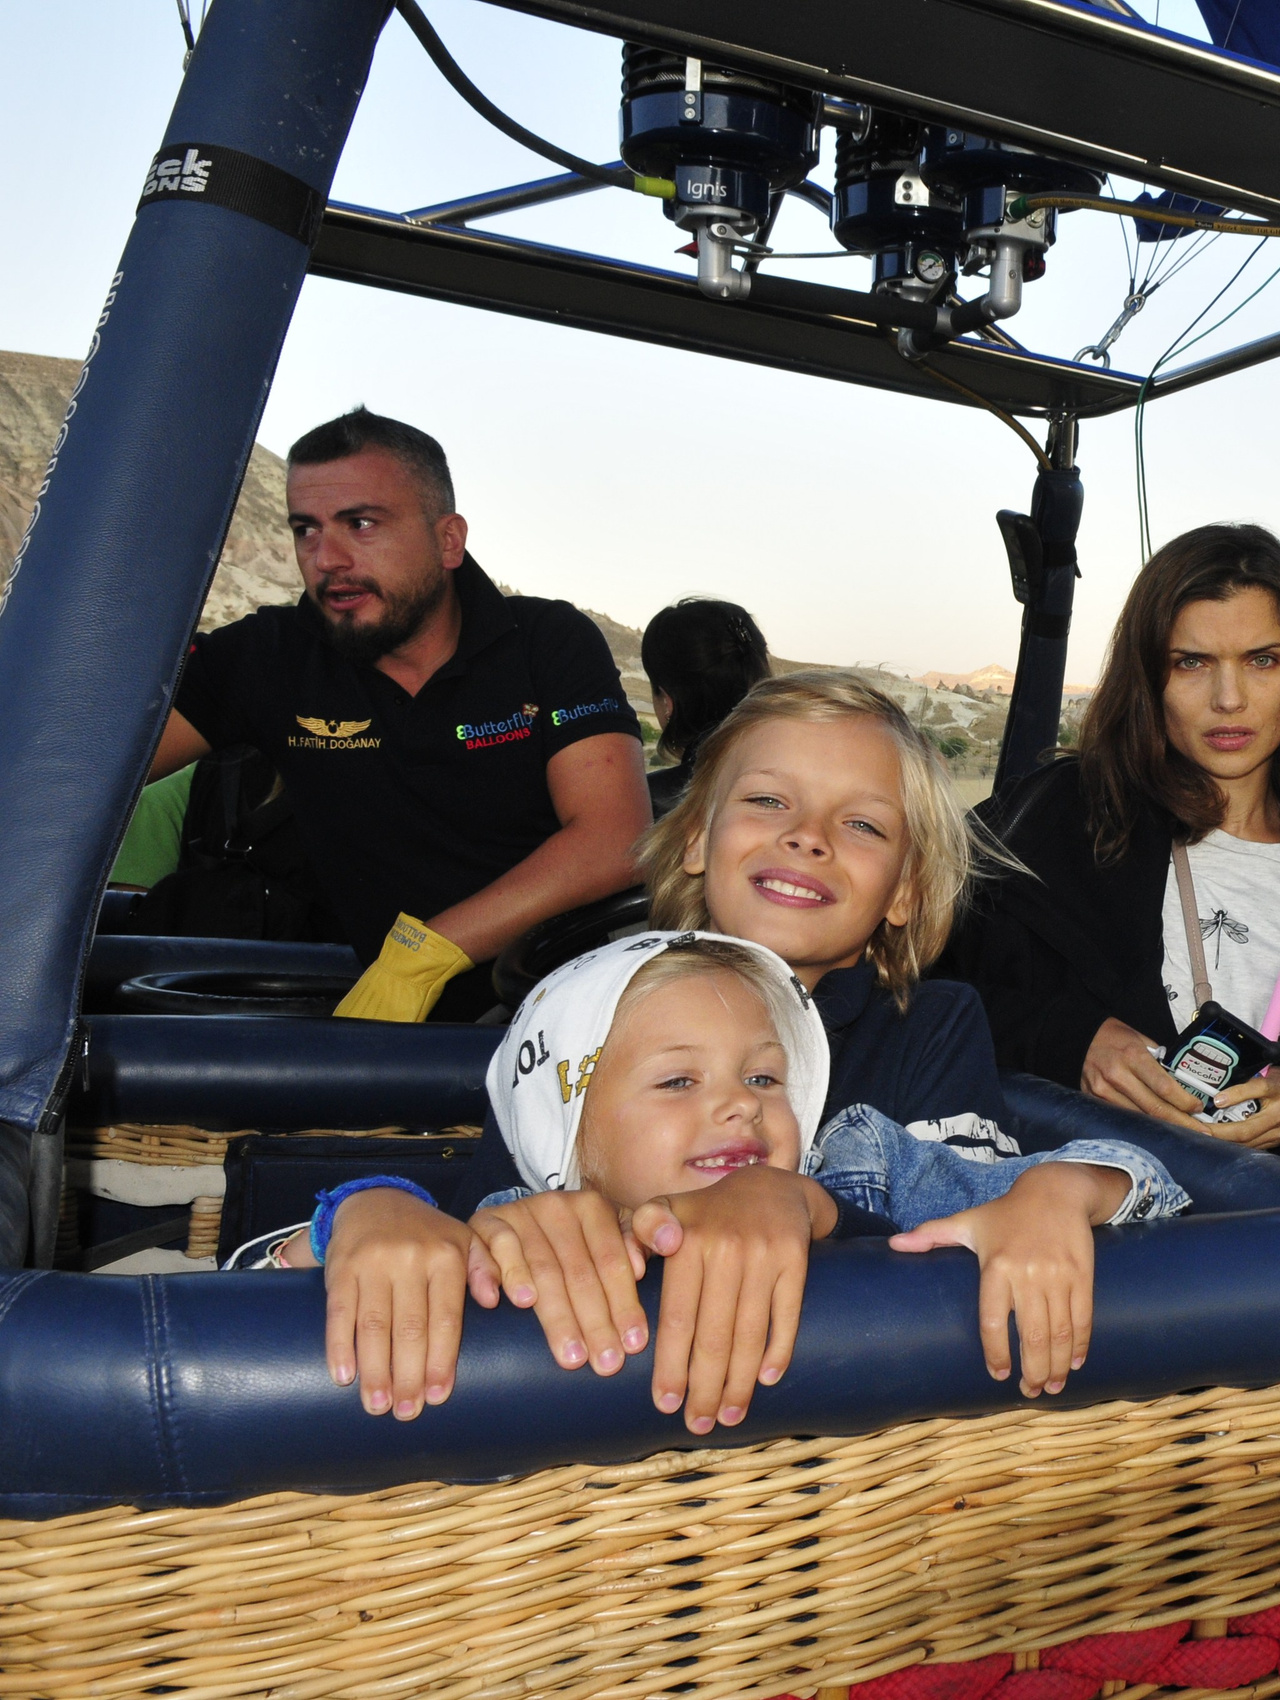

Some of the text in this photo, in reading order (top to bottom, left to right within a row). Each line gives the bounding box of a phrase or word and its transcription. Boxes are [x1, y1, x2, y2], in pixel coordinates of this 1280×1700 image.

[687, 179, 727, 199] Ignis
[463, 711, 534, 740] Butterfly
[465, 726, 531, 750] BALLOONS
[1180, 1060, 1223, 1083] Chocolat
